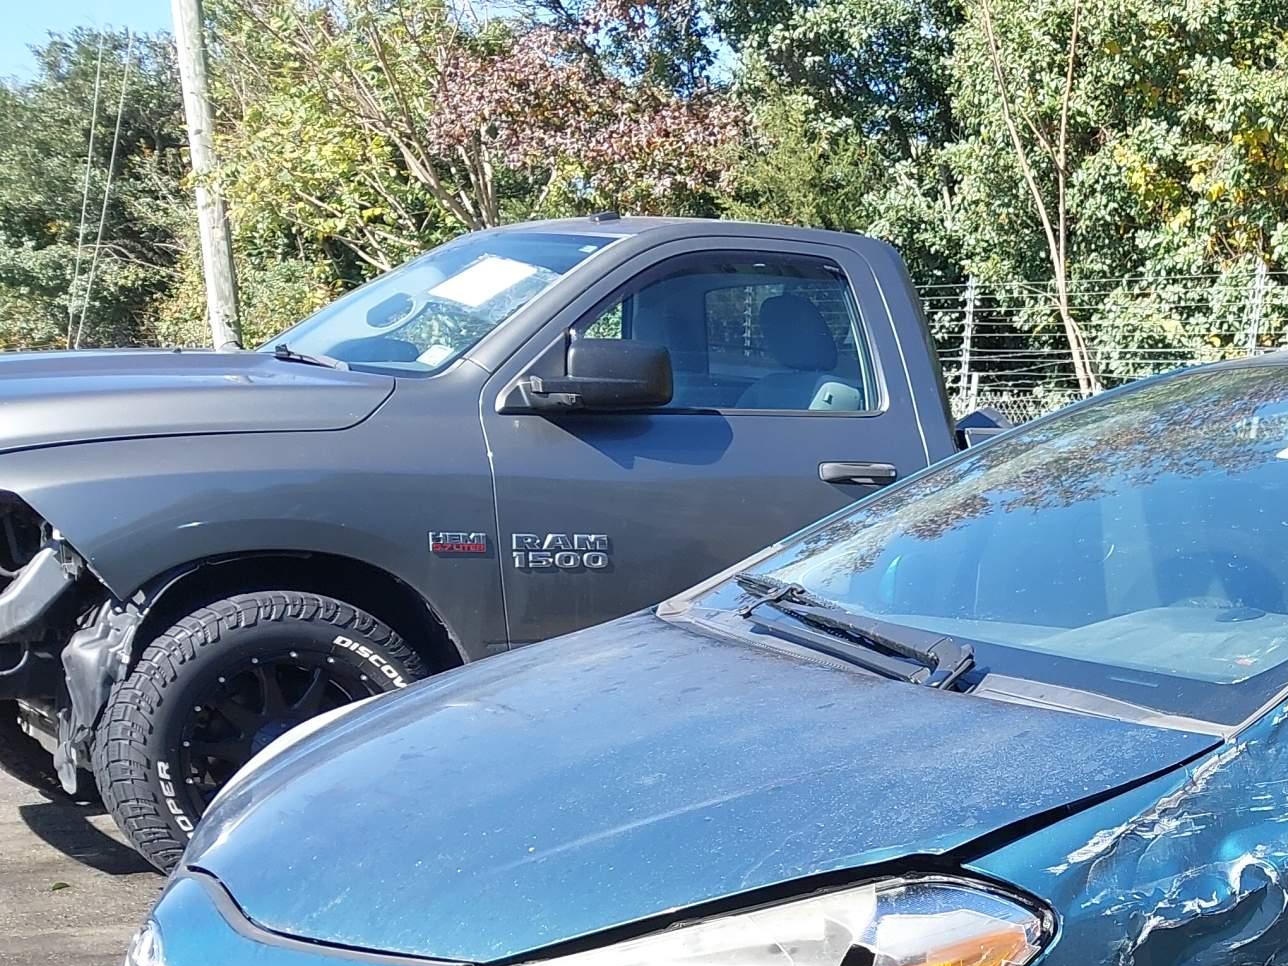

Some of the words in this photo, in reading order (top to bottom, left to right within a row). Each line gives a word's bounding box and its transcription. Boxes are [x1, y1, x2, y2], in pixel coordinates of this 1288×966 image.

[429, 531, 486, 546] HEMI
[512, 533, 608, 550] RAM
[512, 551, 609, 568] 1500
